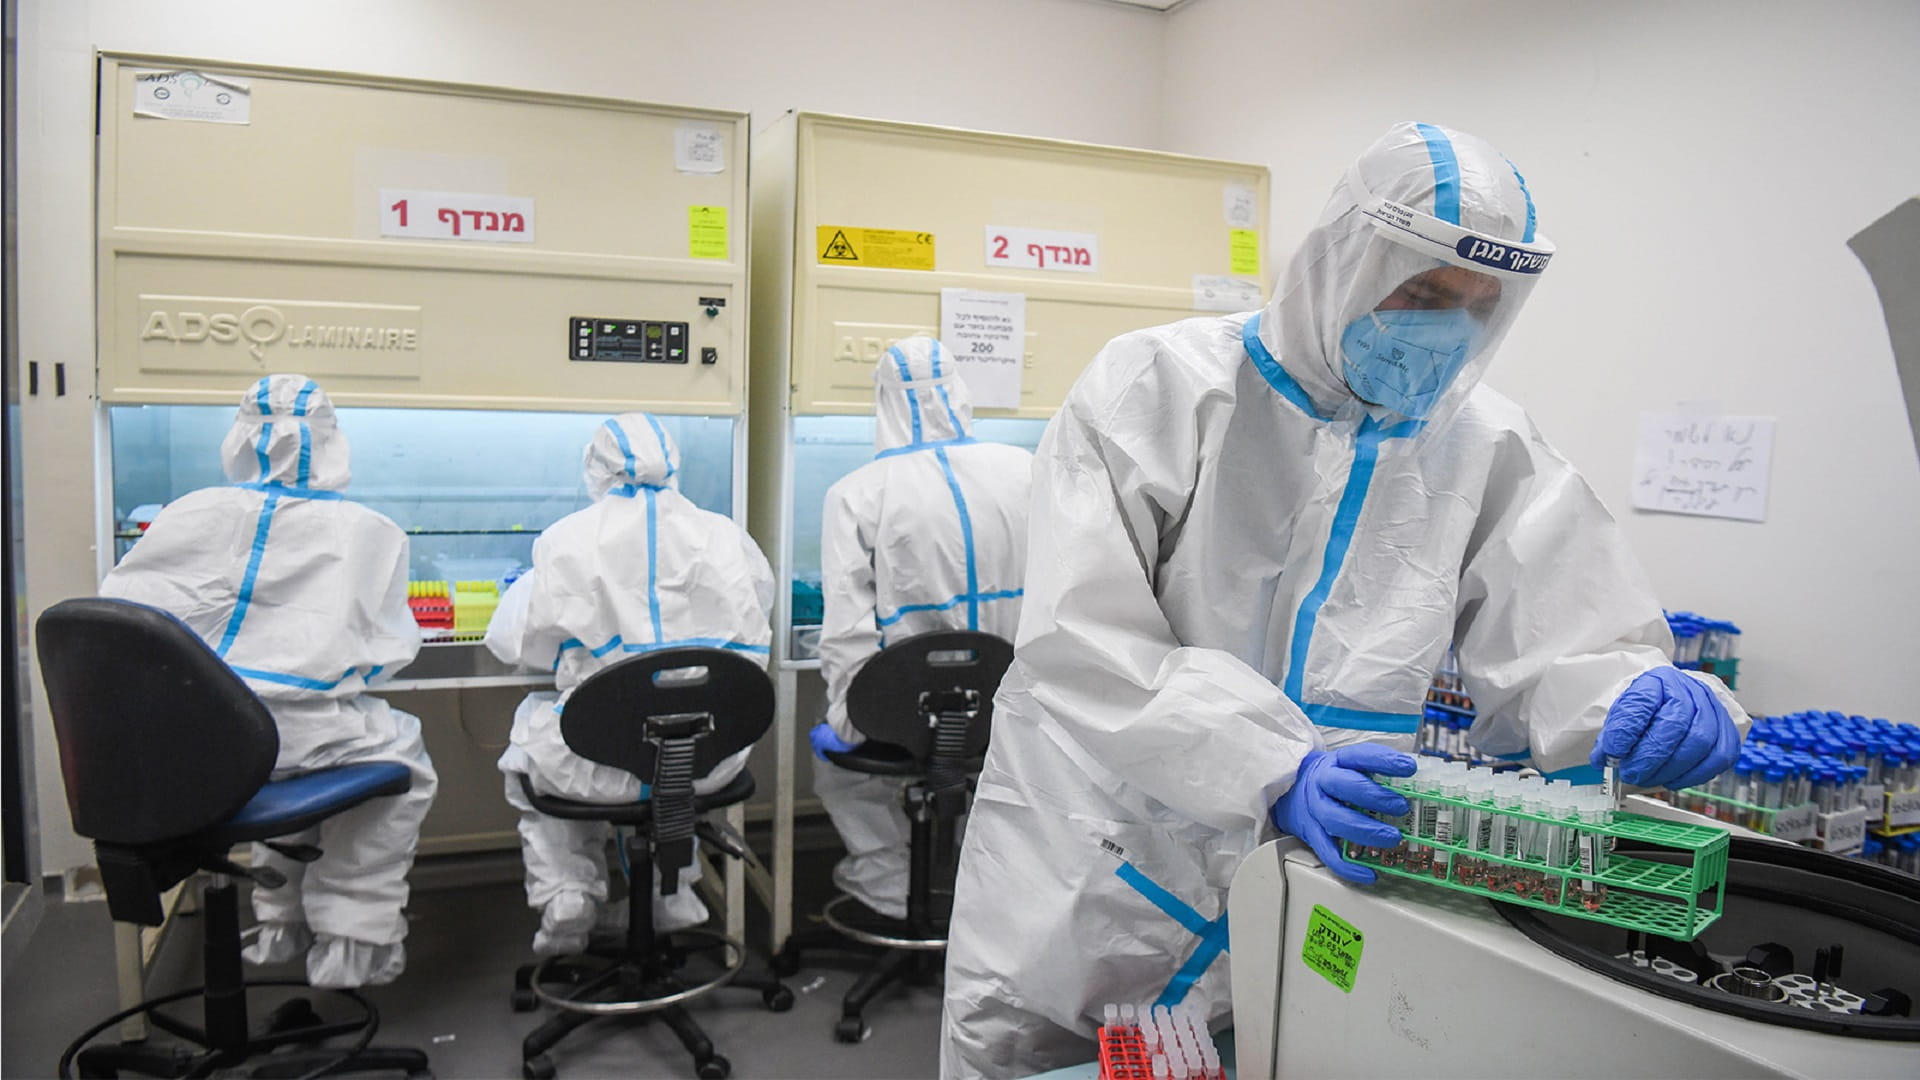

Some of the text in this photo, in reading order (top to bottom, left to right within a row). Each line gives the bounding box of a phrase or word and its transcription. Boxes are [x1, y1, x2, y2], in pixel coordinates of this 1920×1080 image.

[391, 199, 524, 236] מנדף 1
[993, 235, 1091, 268] מנדף 2
[1468, 240, 1550, 270] משקף מגן
[287, 324, 417, 350] LAMINAIRE
[972, 342, 993, 353] 200
